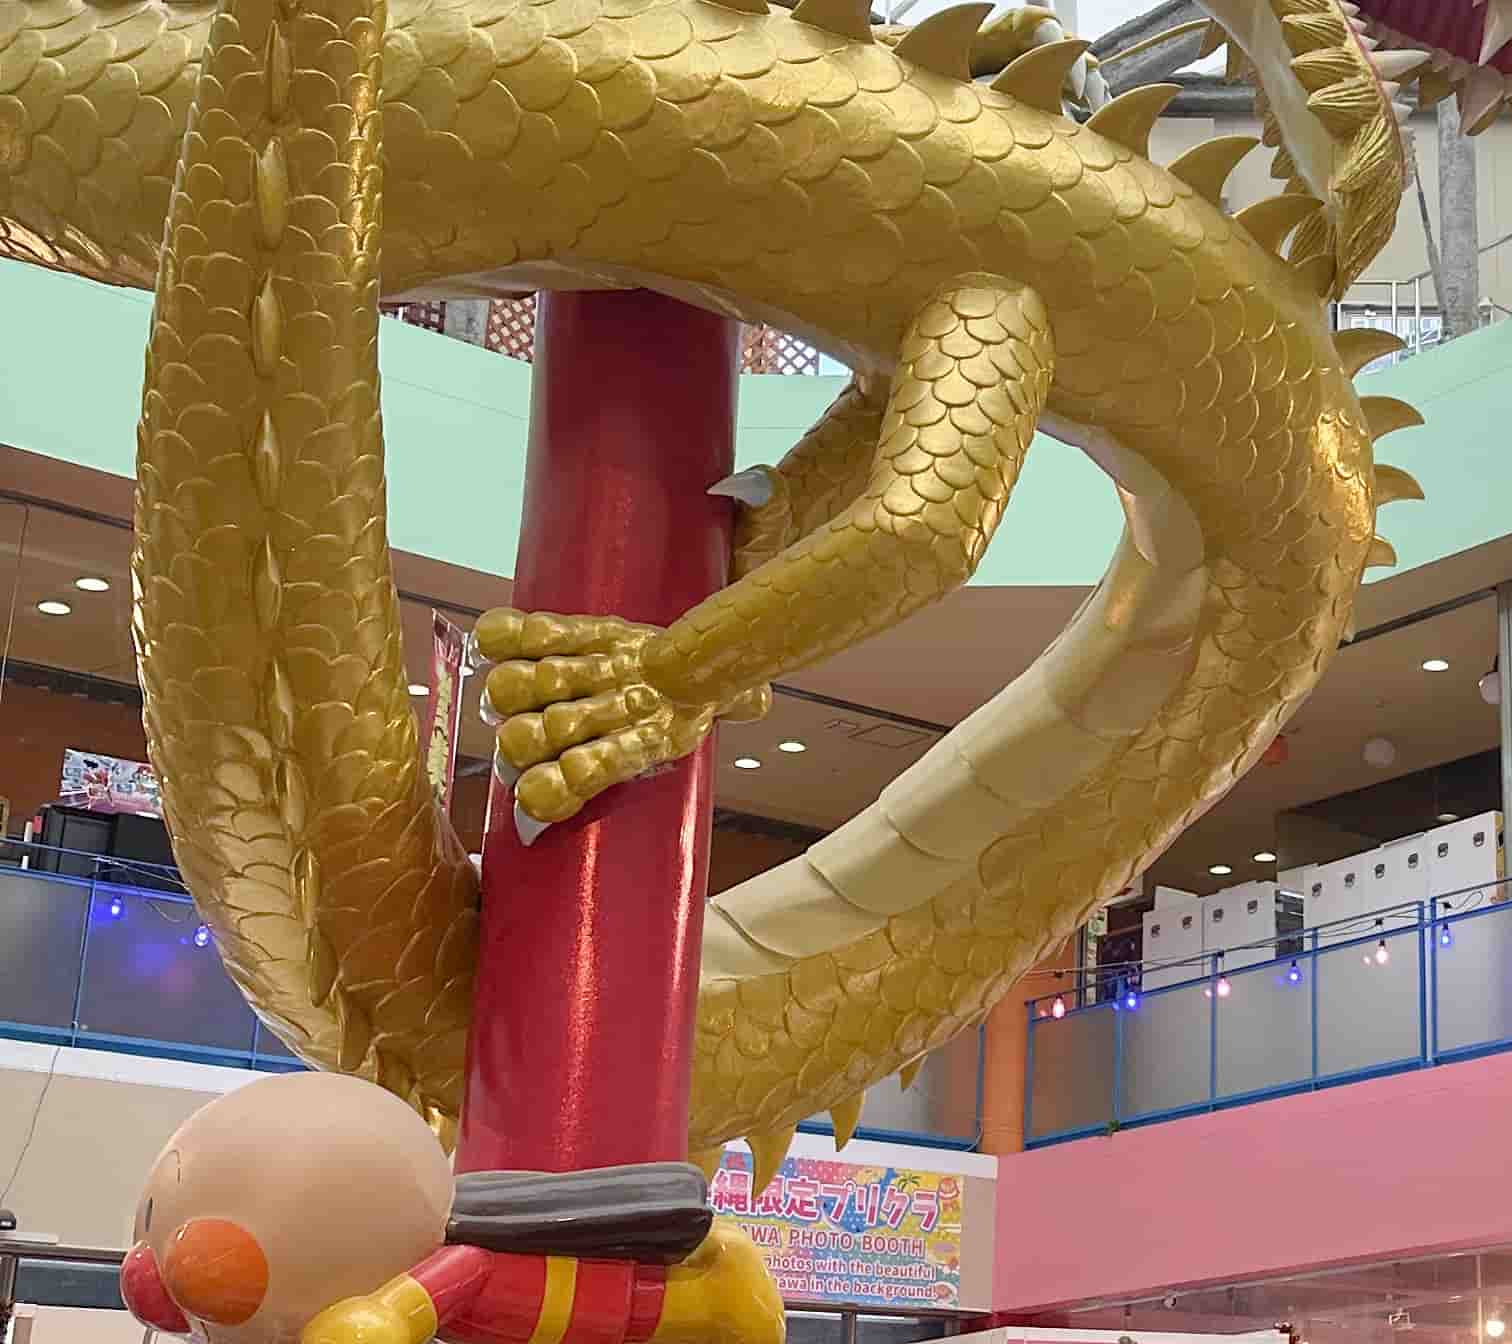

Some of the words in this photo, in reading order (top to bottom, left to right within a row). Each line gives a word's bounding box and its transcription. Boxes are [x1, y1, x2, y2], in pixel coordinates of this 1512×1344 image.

[789, 1228, 854, 1251] PHOTO
[861, 1233, 926, 1257] BOOTH
[815, 1260, 847, 1275] with
[849, 1261, 871, 1277] the
[874, 1262, 937, 1281] beautiful
[828, 1278, 850, 1294] the
